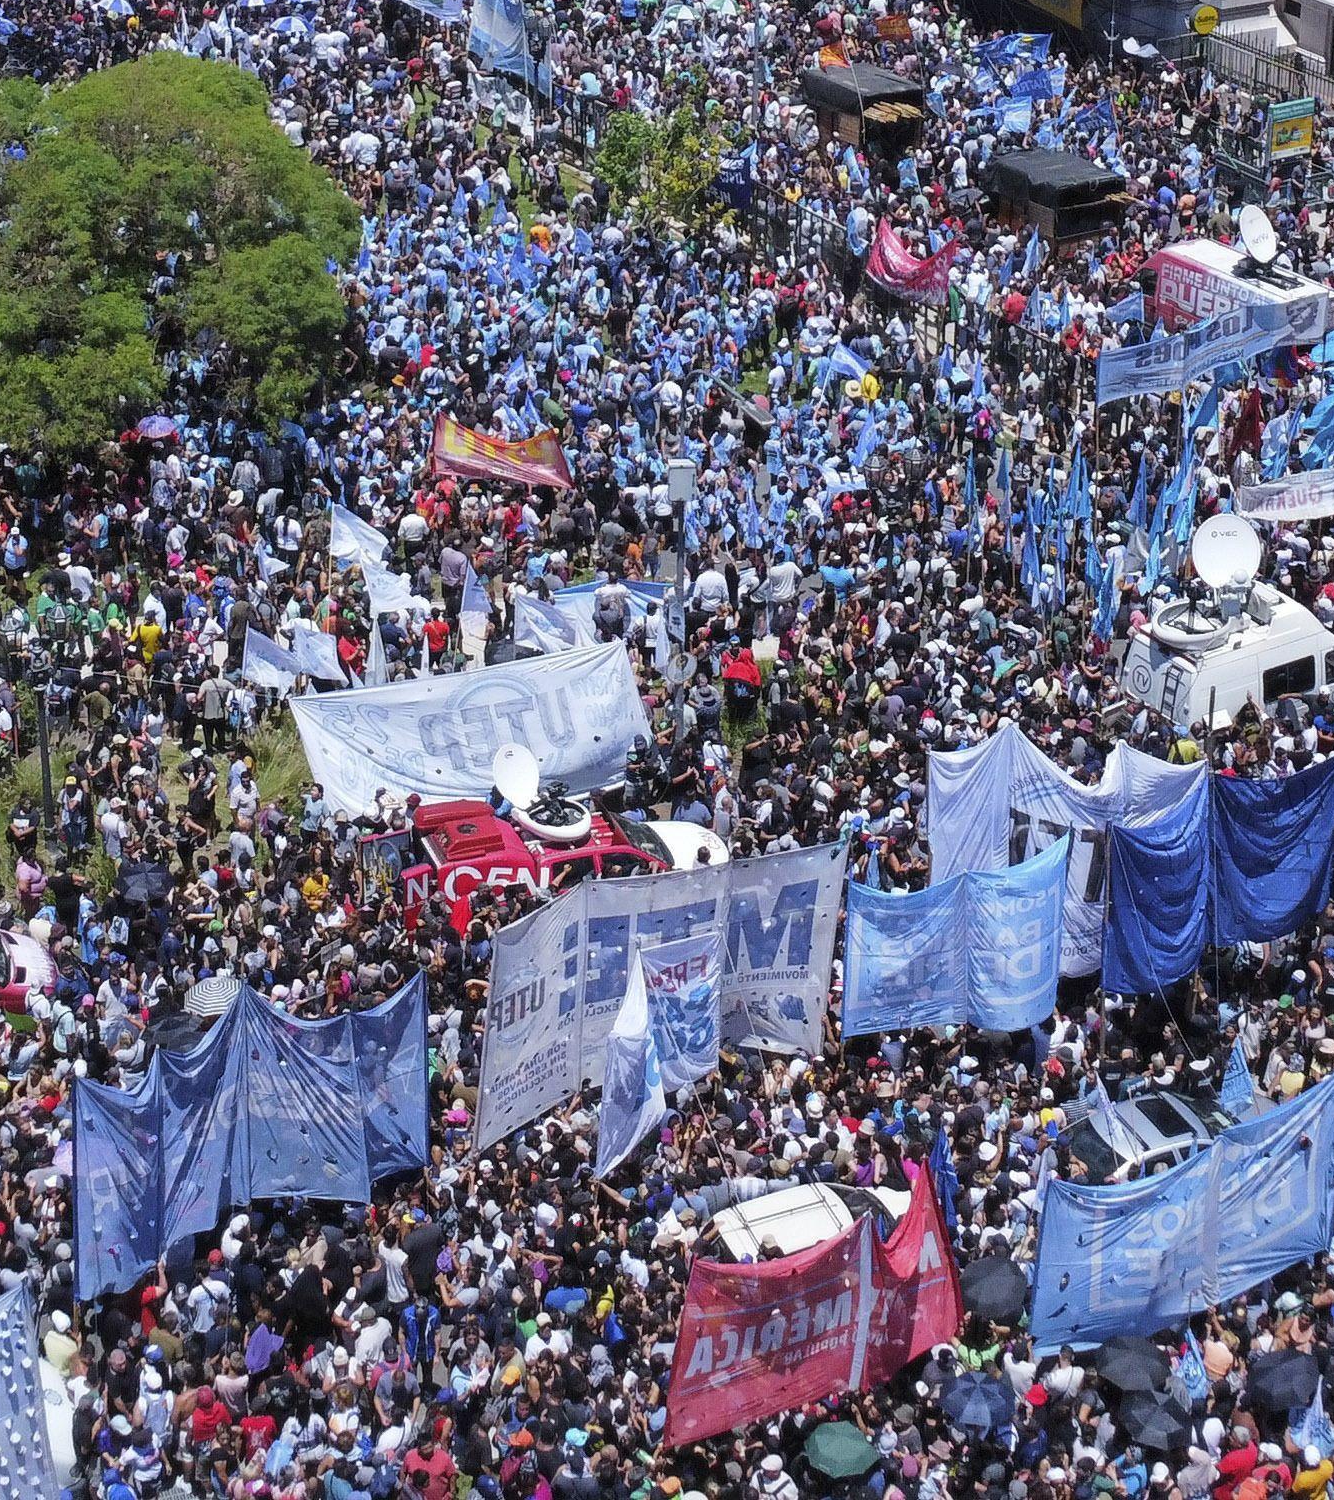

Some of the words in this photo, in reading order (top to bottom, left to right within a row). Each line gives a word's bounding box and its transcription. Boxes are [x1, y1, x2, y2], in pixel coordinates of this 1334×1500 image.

[1161, 263, 1203, 289] FIRME
[1206, 274, 1250, 302] JUNTO
[1135, 671, 1149, 688] TV
[443, 866, 550, 903] C5N
